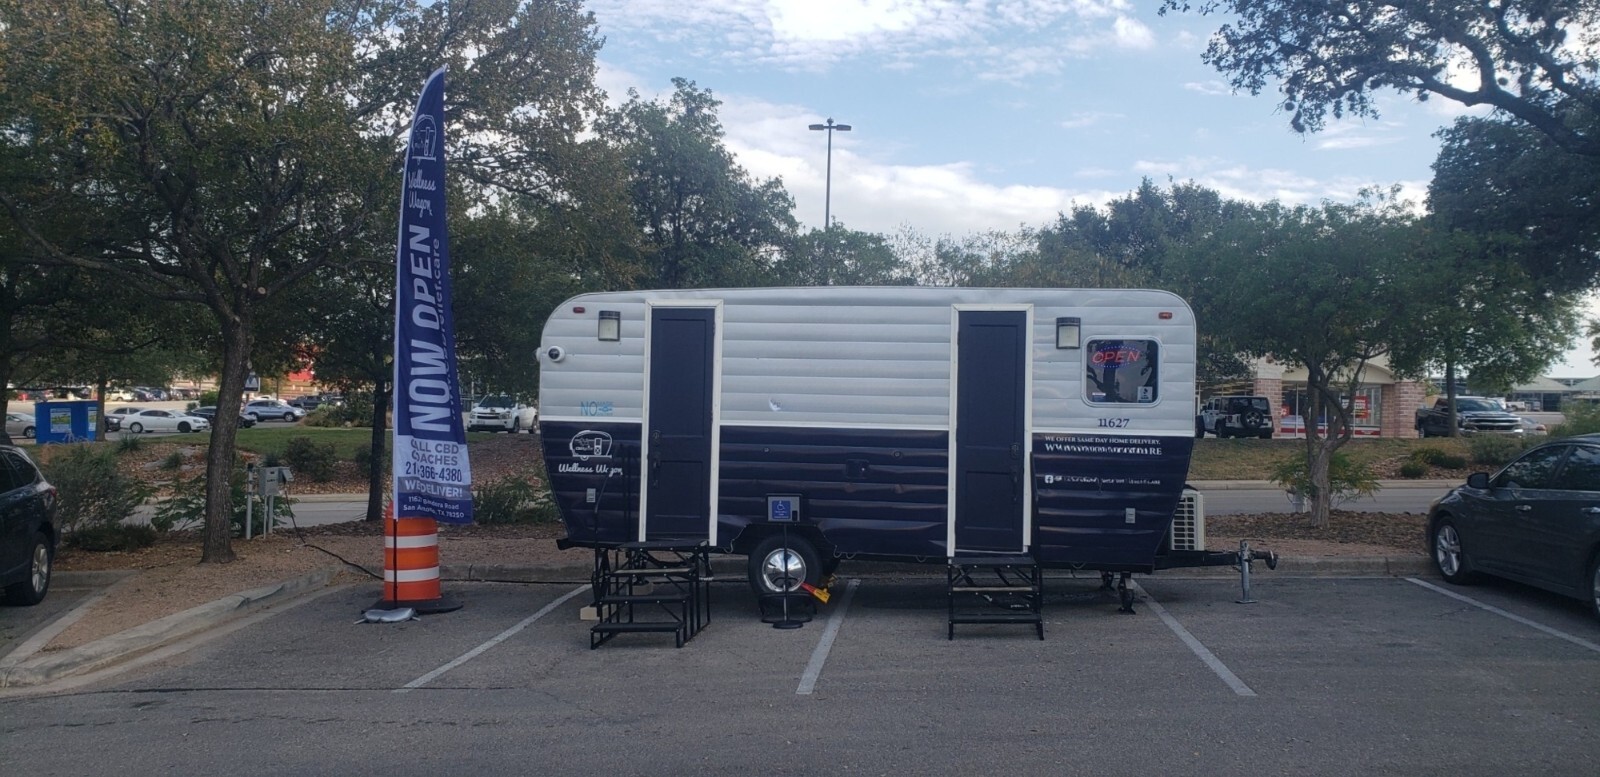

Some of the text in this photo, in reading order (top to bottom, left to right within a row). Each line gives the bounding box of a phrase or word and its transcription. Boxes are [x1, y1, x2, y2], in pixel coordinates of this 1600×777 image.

[408, 169, 436, 191] Wellness
[408, 191, 433, 218] Wagon
[409, 224, 451, 432] NOW OPEN
[1092, 350, 1140, 363] OPEN
[580, 401, 597, 417] NO
[1098, 418, 1130, 428] 11627
[435, 443, 459, 454] CBD
[405, 461, 462, 482] 21-366-4380
[558, 462, 594, 473] Wellness
[420, 484, 463, 498] DELIVER!
[444, 502, 460, 510] Road
